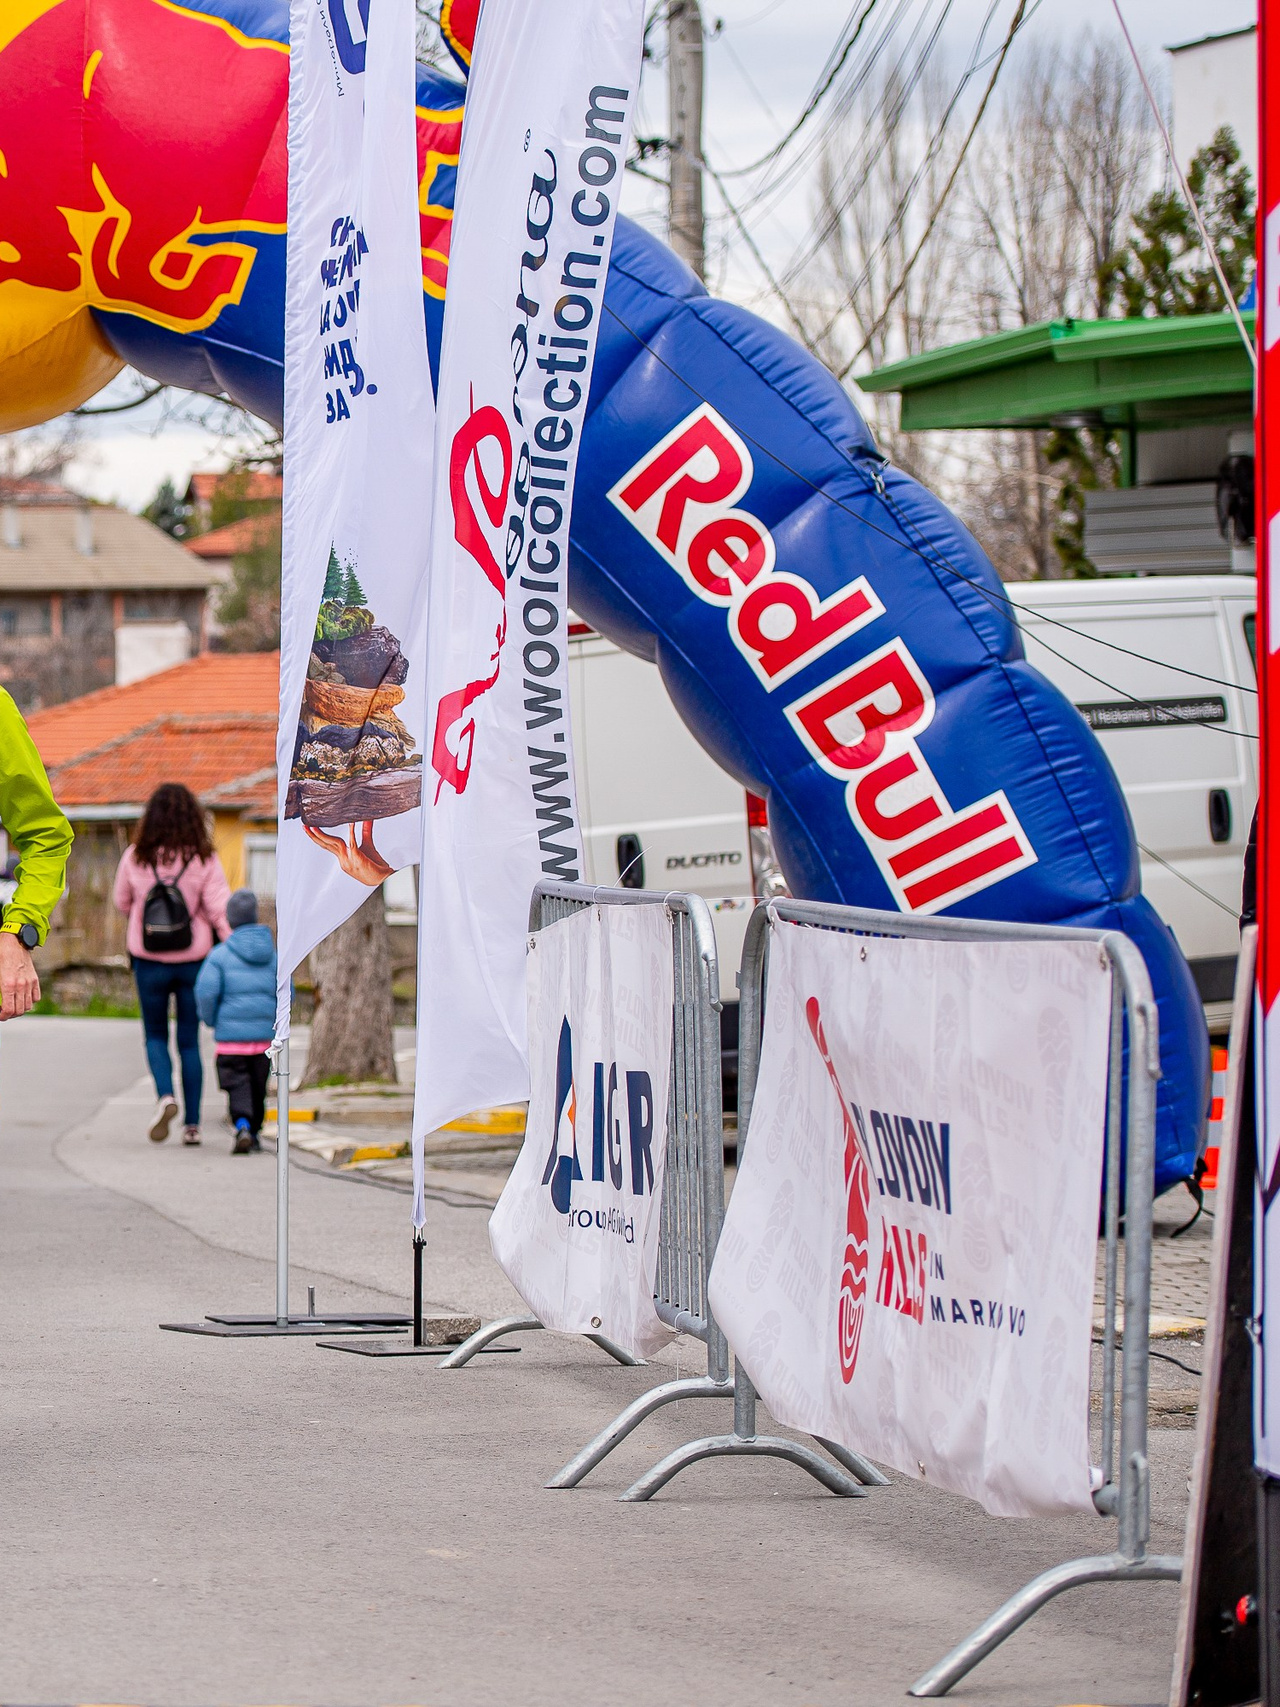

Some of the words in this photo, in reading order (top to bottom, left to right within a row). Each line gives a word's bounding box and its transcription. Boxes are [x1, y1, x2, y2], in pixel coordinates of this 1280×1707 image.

[521, 85, 629, 882] www.woolcollection.com
[618, 412, 876, 680] Red
[666, 852, 742, 869] DUCATO
[794, 648, 1025, 911] Bull
[851, 1101, 952, 1215] POVDIV
[930, 1250, 945, 1282] IN
